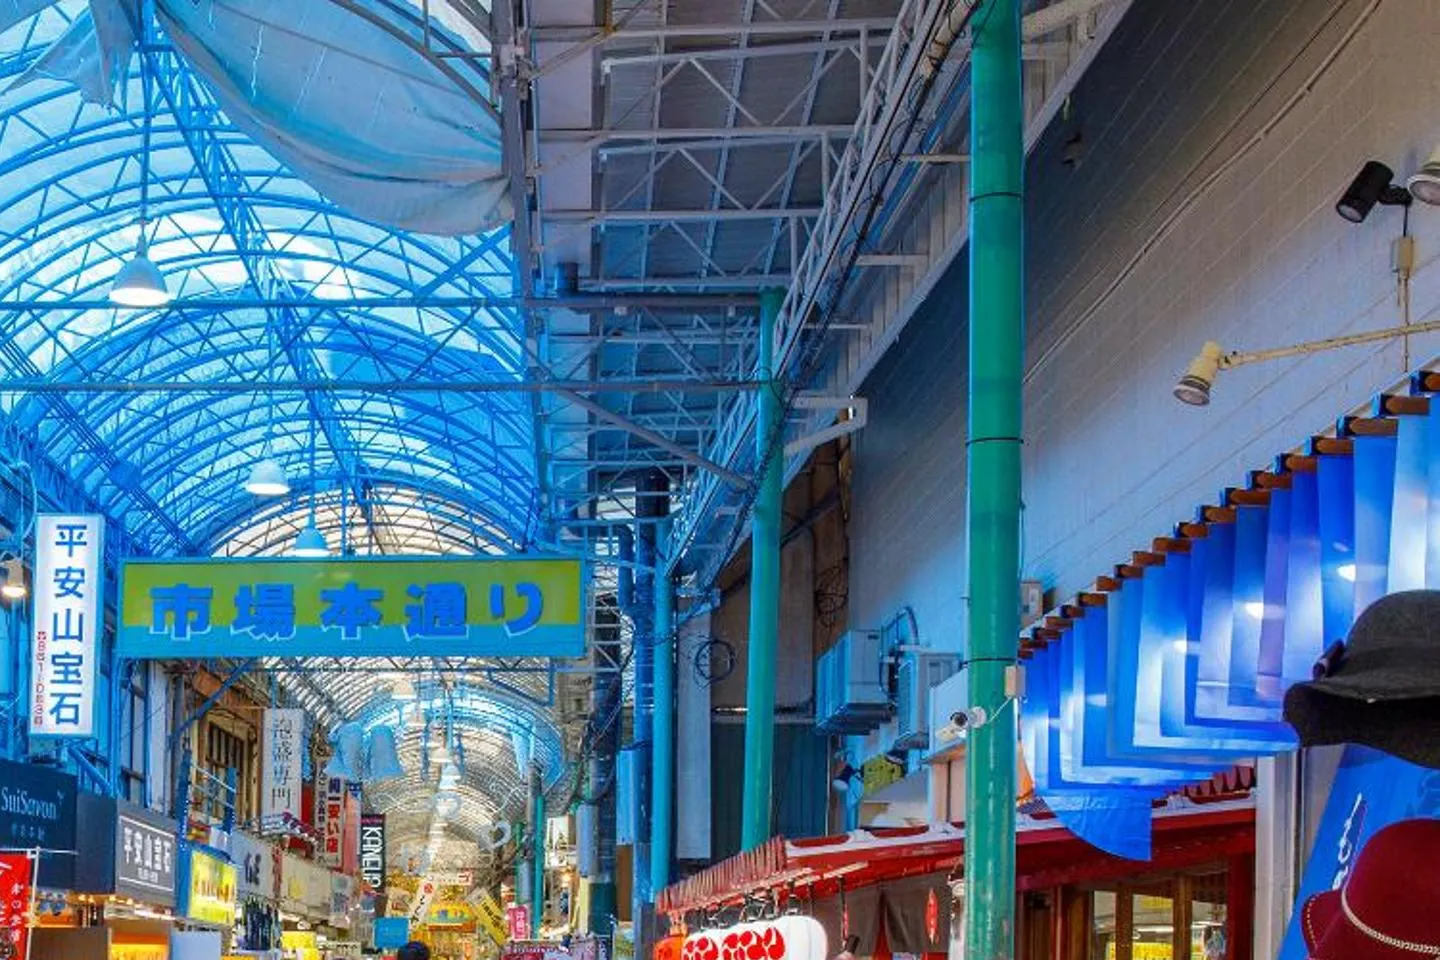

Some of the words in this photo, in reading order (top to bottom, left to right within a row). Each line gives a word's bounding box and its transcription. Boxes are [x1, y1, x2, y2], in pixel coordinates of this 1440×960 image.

[49, 523, 88, 726] 平安山宝石
[150, 580, 545, 641] 市場本通り
